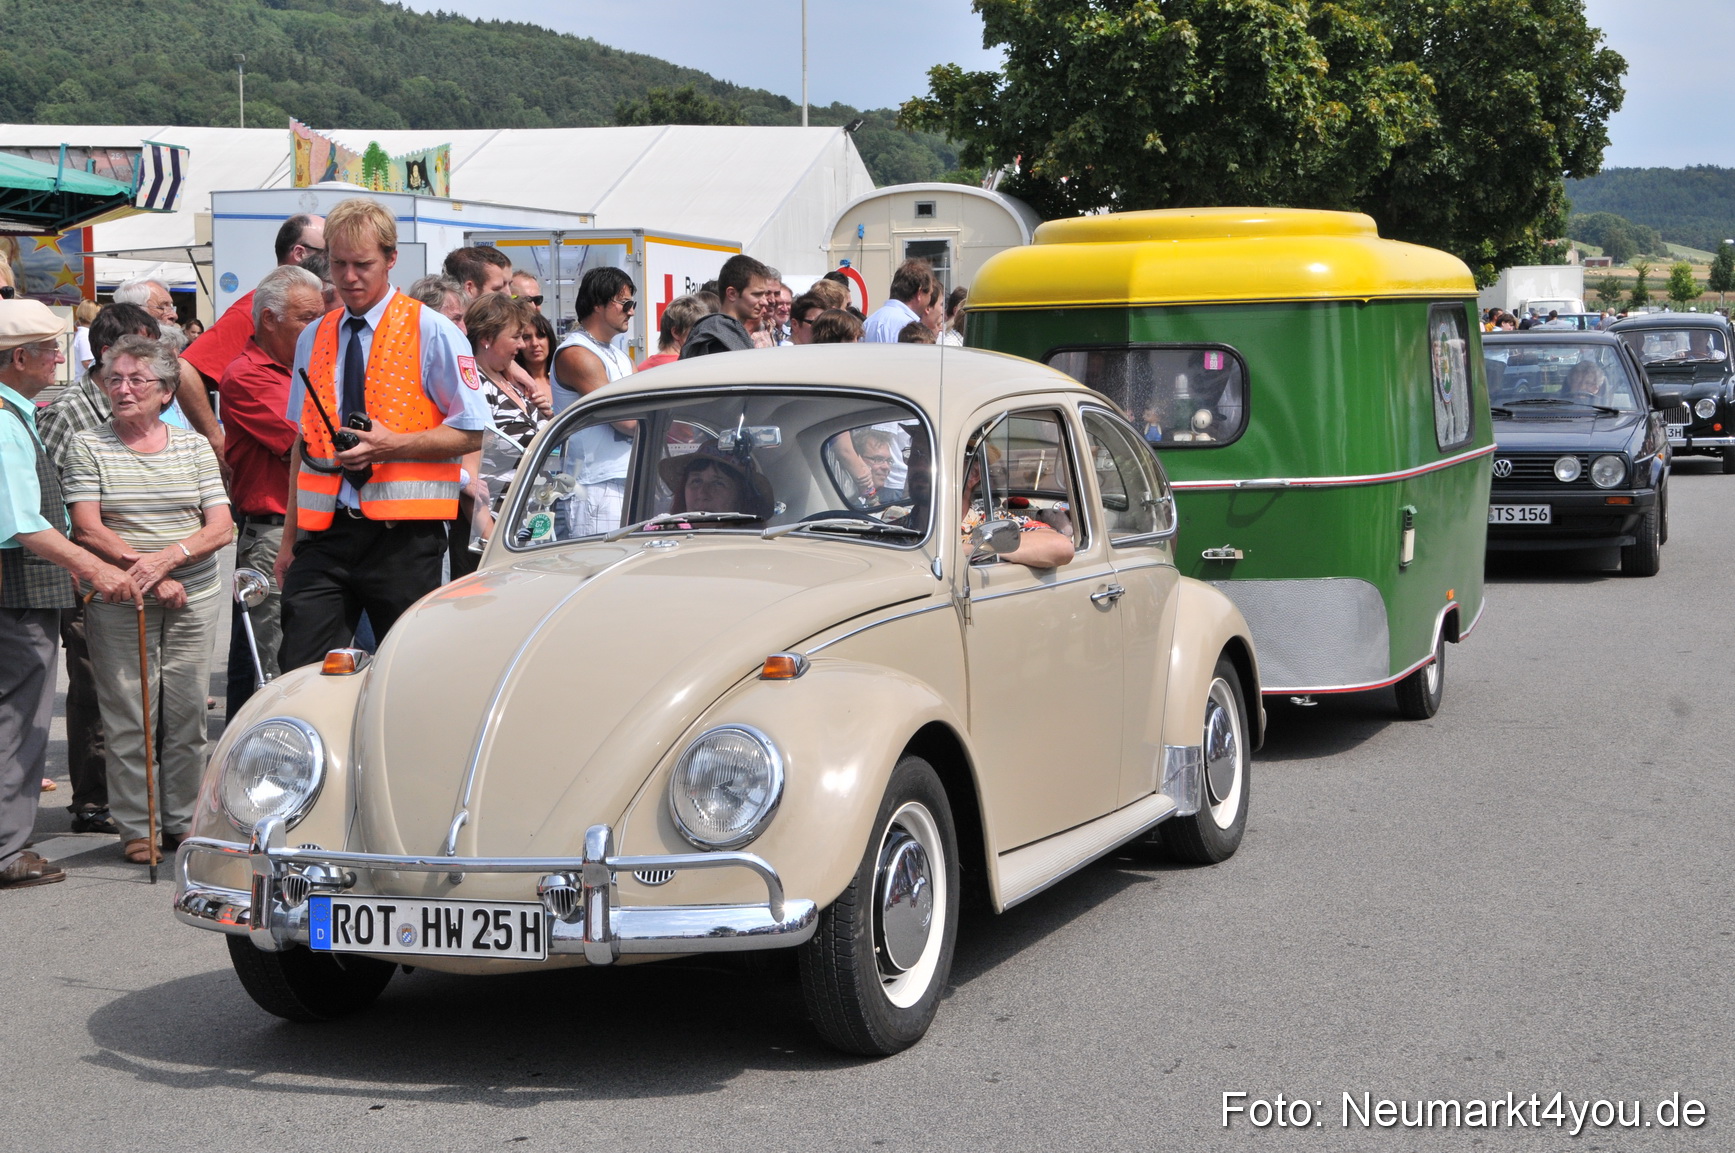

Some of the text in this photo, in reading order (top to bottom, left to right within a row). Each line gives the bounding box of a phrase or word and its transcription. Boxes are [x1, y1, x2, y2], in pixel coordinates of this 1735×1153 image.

[1495, 507, 1548, 522] TS 156
[332, 903, 397, 946] ROT
[316, 928, 325, 940] D
